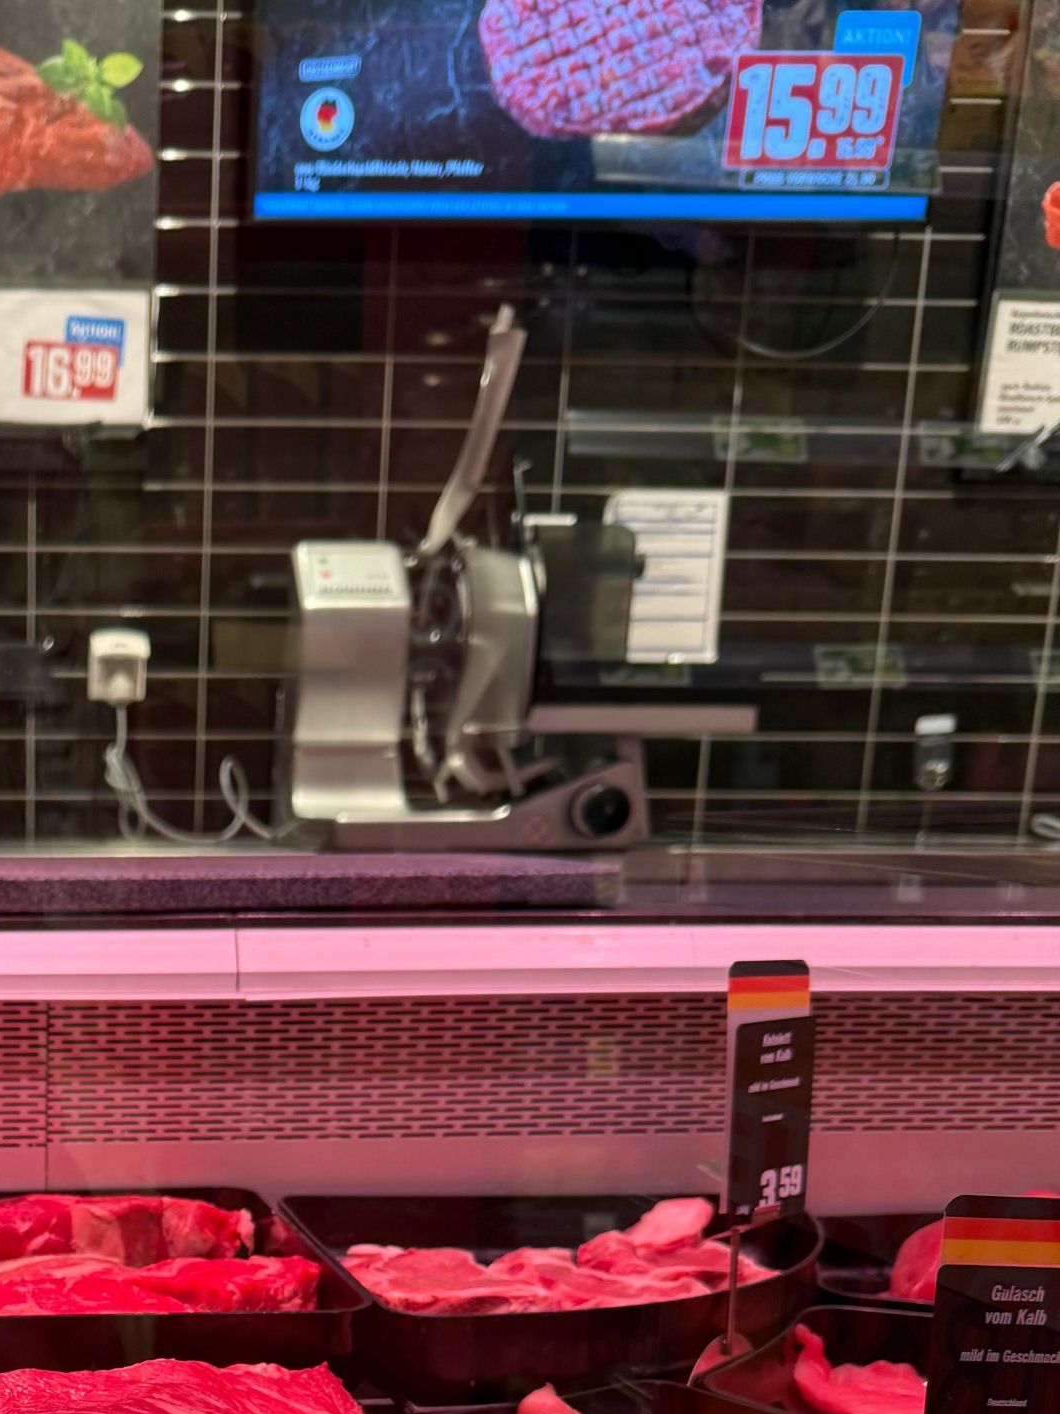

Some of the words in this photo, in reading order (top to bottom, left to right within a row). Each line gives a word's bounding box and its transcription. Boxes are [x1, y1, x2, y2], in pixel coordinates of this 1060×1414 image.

[738, 63, 893, 160] 15.99
[991, 1284, 1045, 1302] Gulasch
[985, 1311, 1012, 1325] vom
[1015, 1308, 1047, 1326] Kalb
[959, 1349, 983, 1362] mild
[985, 1349, 1000, 1362] im
